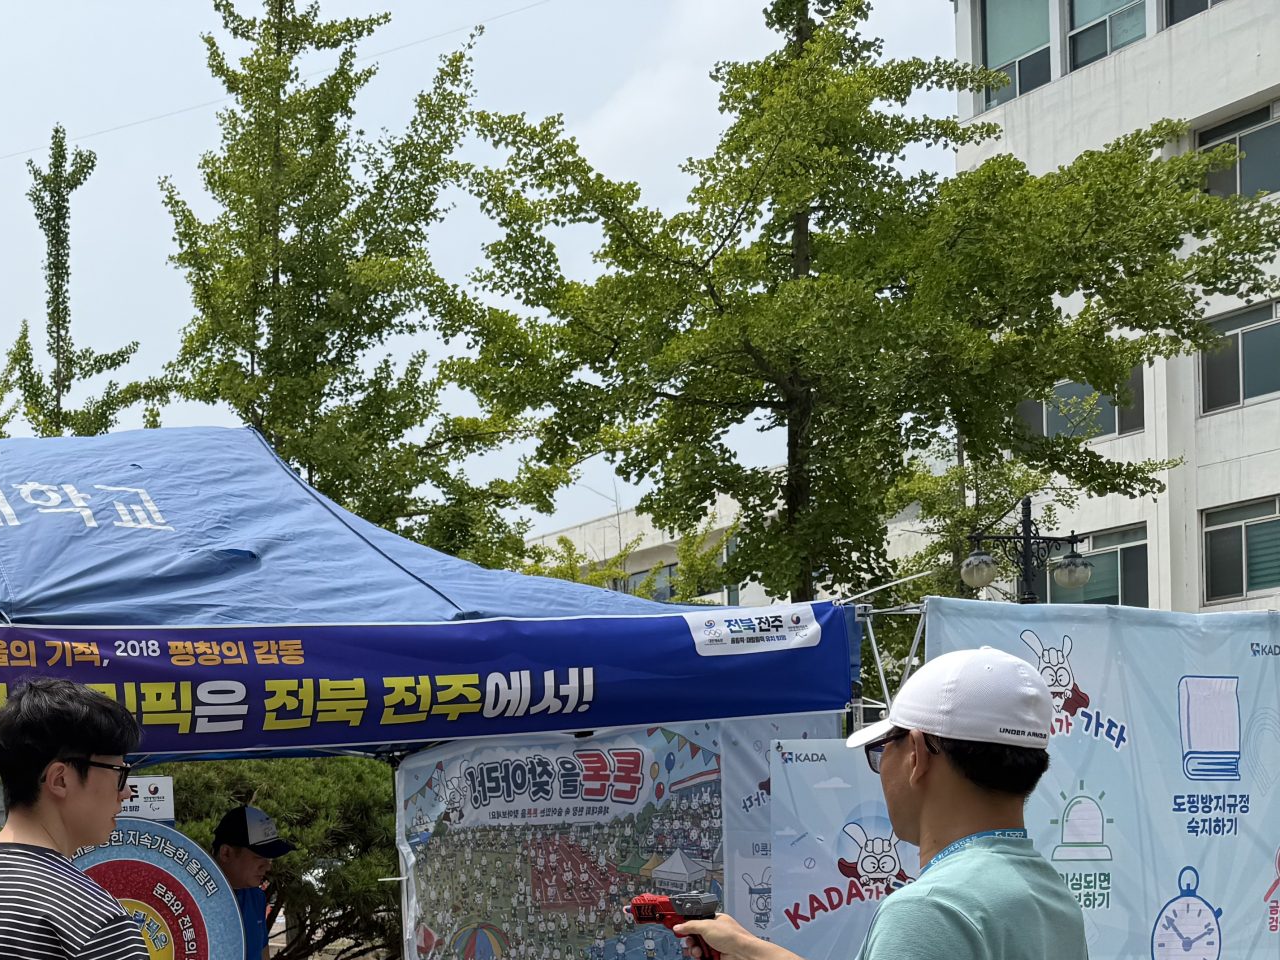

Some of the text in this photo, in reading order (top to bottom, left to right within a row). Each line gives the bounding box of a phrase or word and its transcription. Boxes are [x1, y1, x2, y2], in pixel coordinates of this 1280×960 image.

[724, 615, 784, 634] 전북 전주
[46, 640, 111, 668] 기적,
[115, 639, 161, 659] 2018
[166, 640, 249, 667] 평창의
[254, 640, 306, 666] 감동
[262, 679, 368, 731] 전북
[380, 666, 595, 725] 전주에서!
[999, 727, 1026, 736] UNDER
[1081, 710, 1127, 749] 가다
[794, 753, 827, 763] KADA
[1172, 794, 1250, 814] 도핑방지규정
[1186, 817, 1238, 836] 숙지하기
[126, 830, 189, 866] 지속가능한
[186, 857, 220, 897] 올림픽
[152, 882, 185, 917] 문화와
[178, 914, 198, 955] 전통의
